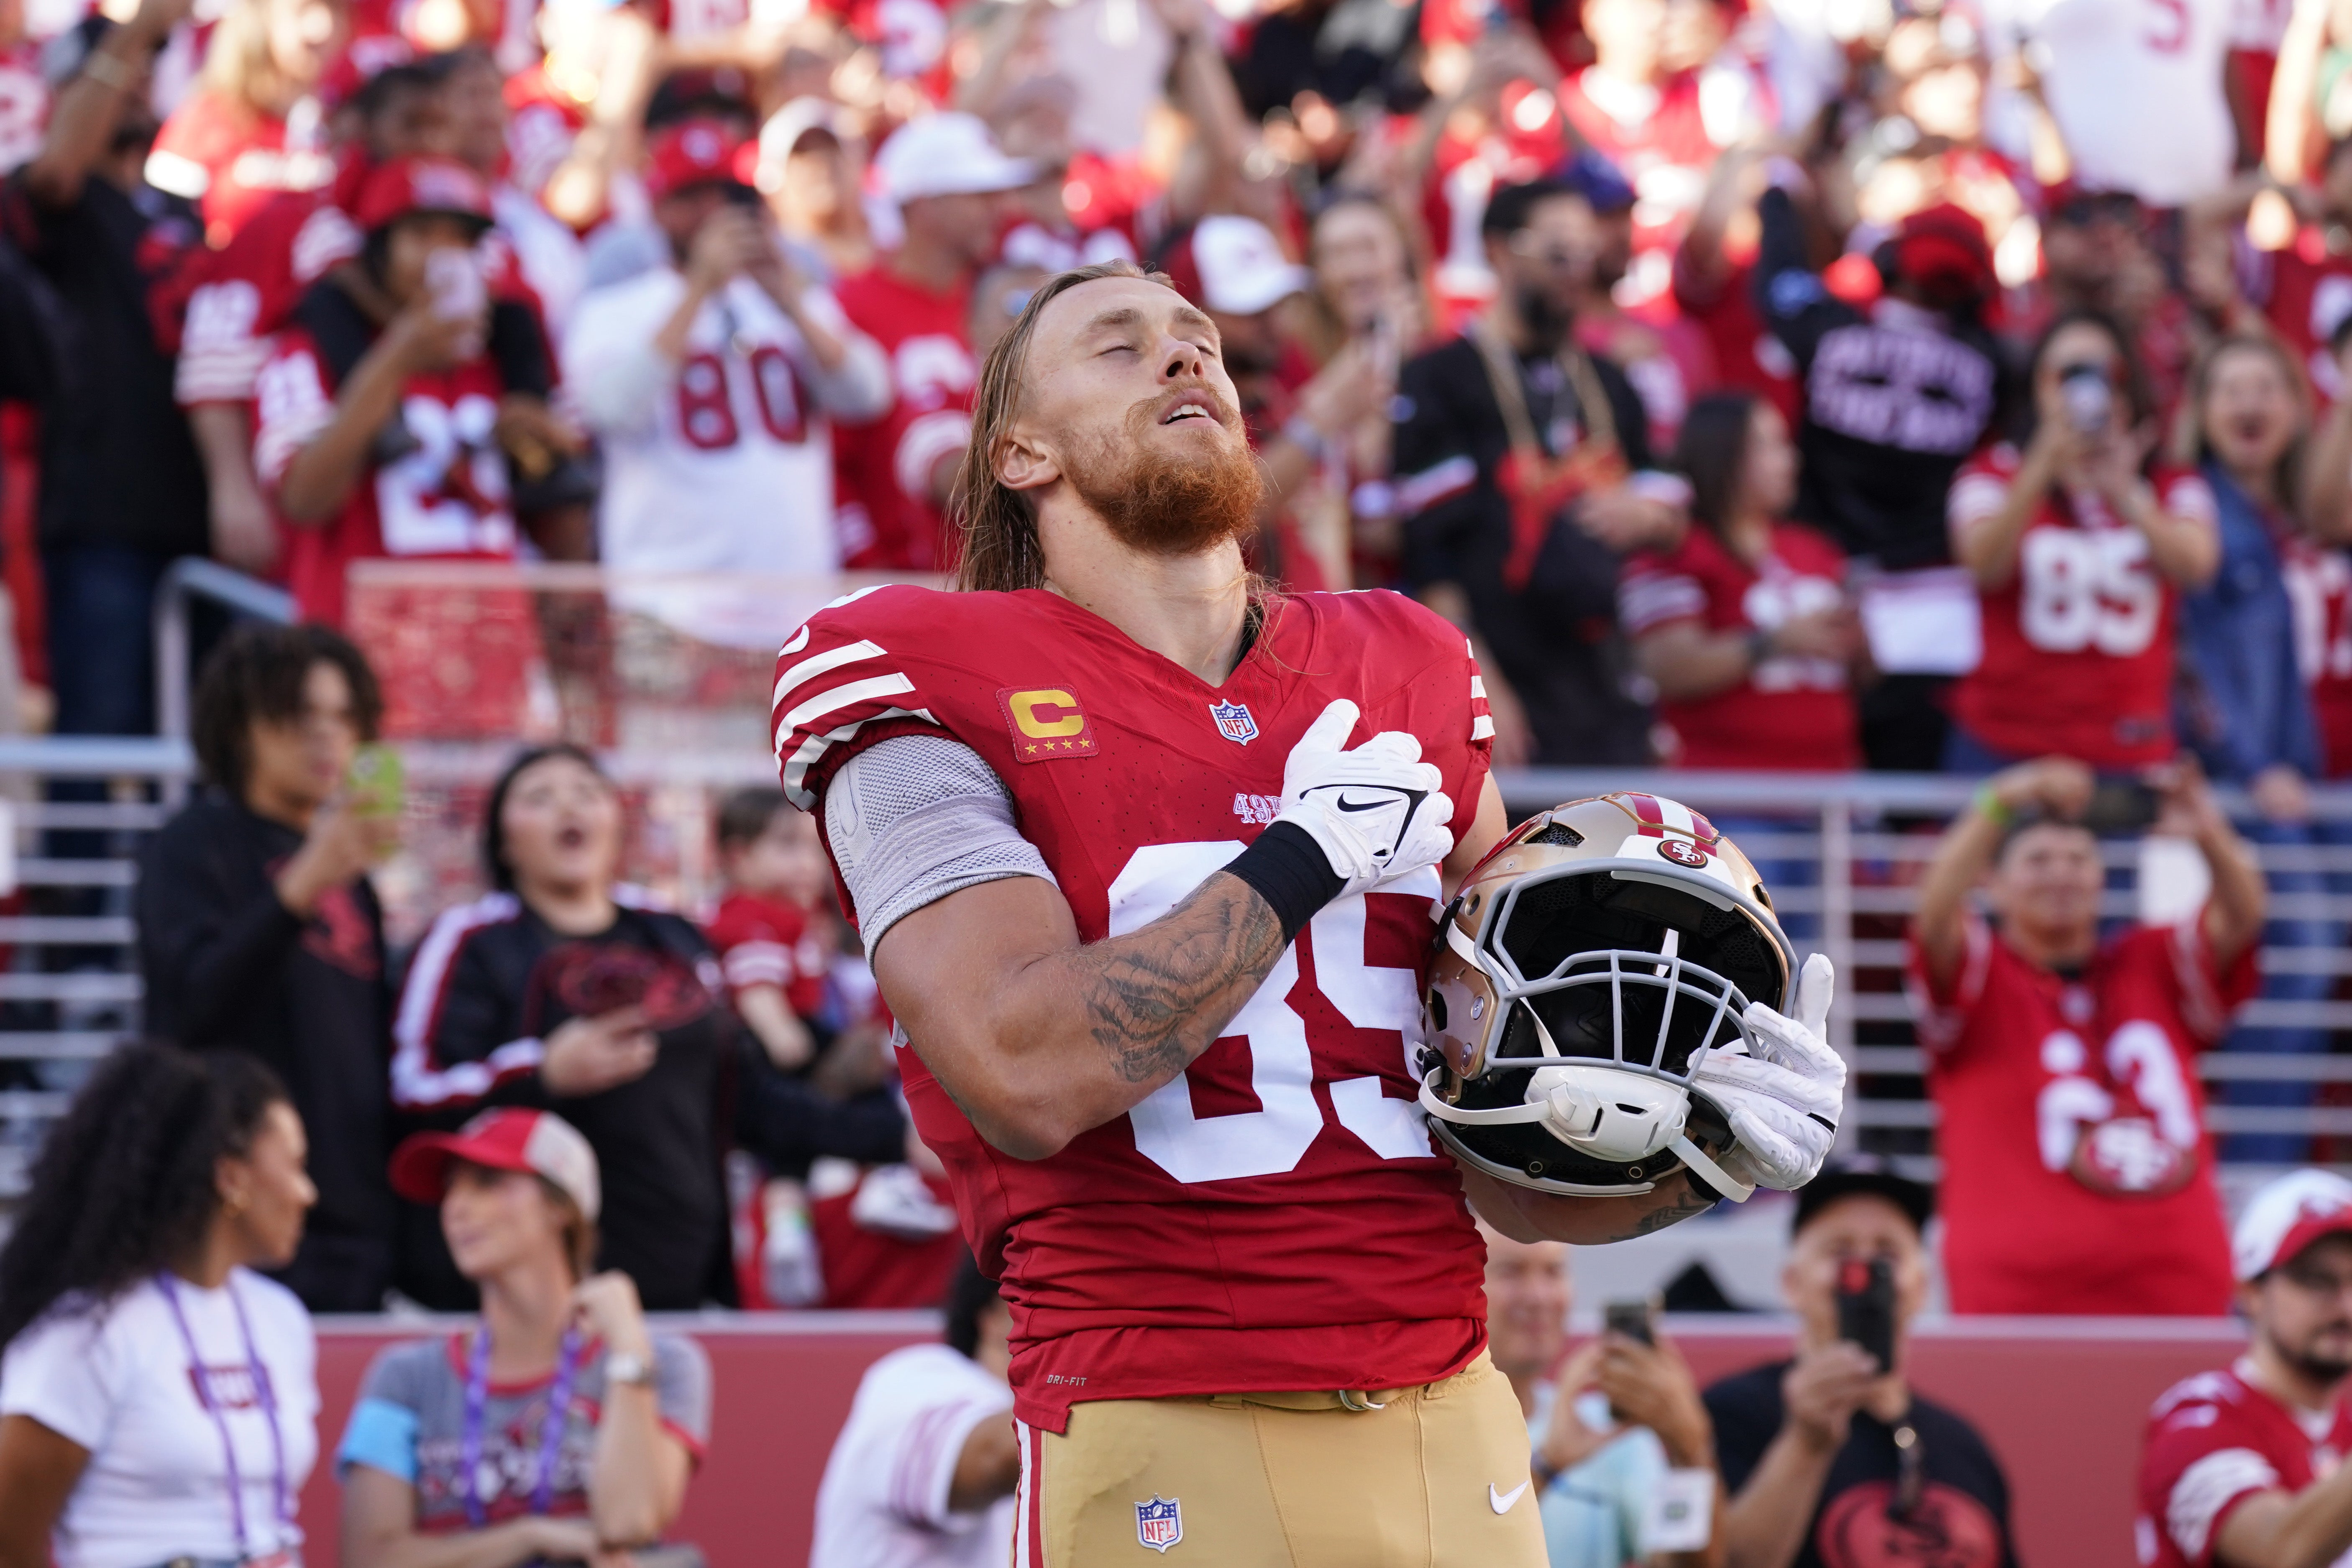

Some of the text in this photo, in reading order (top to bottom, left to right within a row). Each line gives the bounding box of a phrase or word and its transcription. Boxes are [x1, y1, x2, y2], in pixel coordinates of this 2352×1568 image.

[2019, 525, 2163, 657] 85
[1008, 689, 1084, 739] C
[1223, 719, 1252, 736] NFL
[1047, 1374, 1087, 1386] DRI-FIT
[1144, 1519, 1176, 1542] NFL
